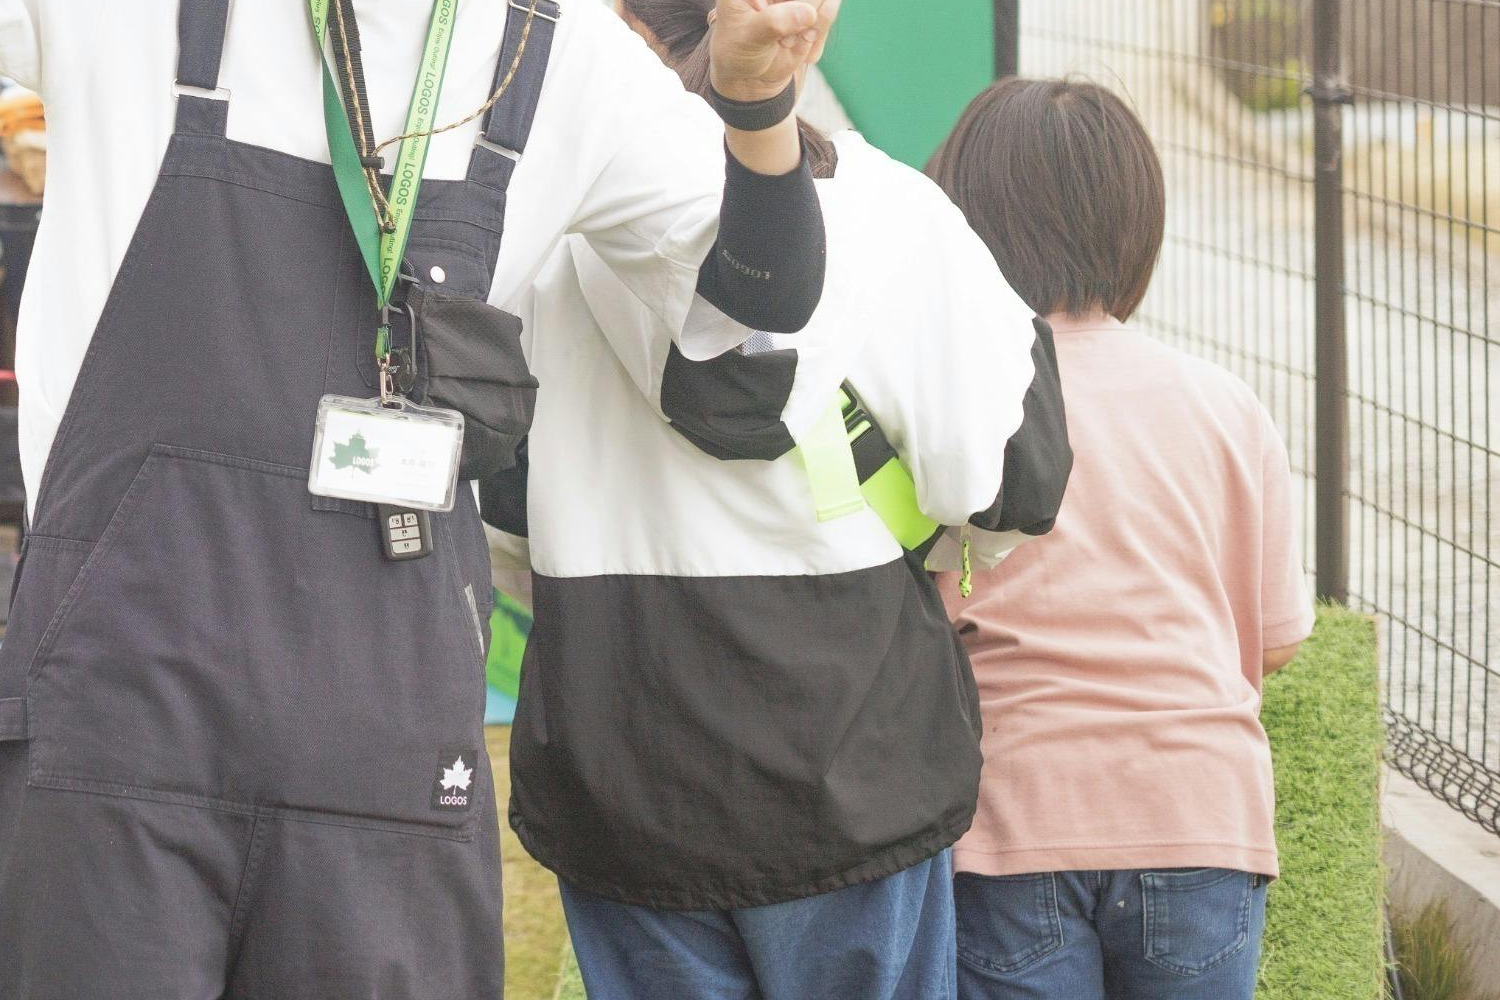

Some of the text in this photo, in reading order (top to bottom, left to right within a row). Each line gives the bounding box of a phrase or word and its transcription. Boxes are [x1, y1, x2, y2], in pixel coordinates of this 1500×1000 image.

[418, 71, 436, 115] LOGOS
[396, 162, 415, 206] LOGOS
[440, 795, 467, 805] LOGOS
